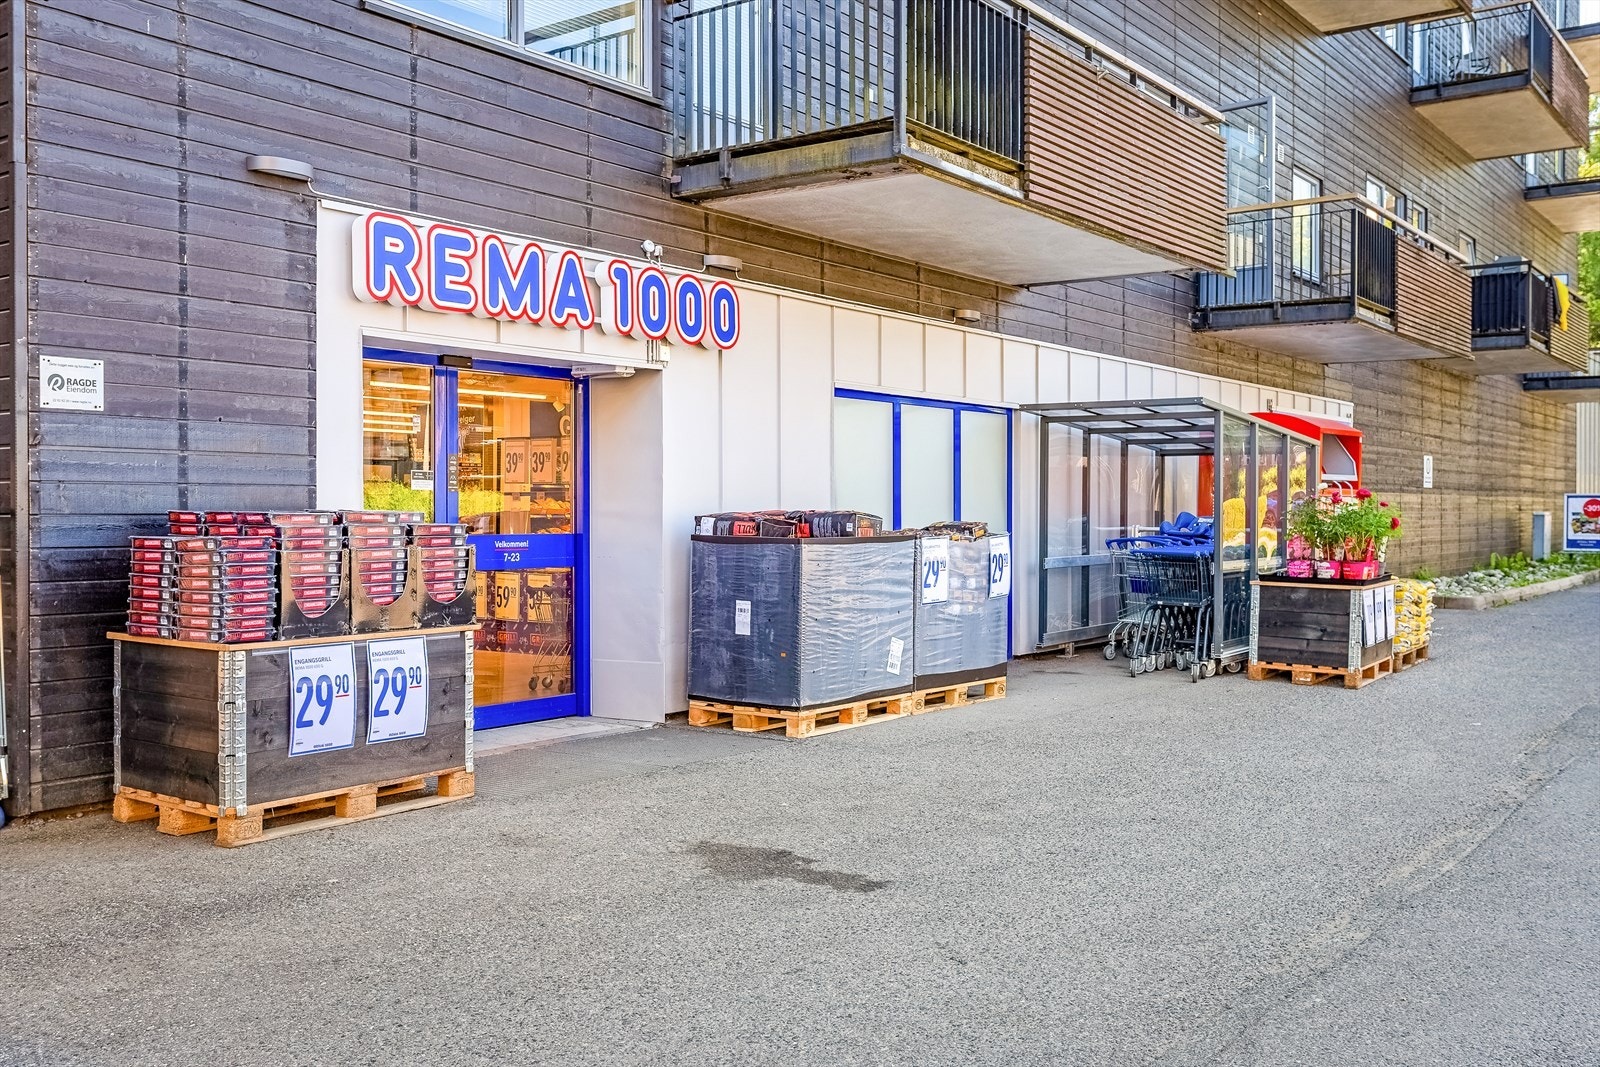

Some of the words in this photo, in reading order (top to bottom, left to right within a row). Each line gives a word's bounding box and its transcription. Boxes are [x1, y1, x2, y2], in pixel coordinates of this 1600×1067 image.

[366, 211, 595, 330] REMA
[608, 259, 740, 350] 1000
[66, 377, 97, 387] RAGDE
[66, 385, 98, 394] Eiendom
[494, 540, 529, 548] Velkommen!
[503, 552, 520, 562] 7-23
[923, 556, 940, 589] 29
[992, 553, 1004, 584] 29
[496, 585, 510, 609] 59
[294, 656, 332, 666] ENGANGSGRILL
[372, 649, 406, 658] ENGANGSGRILL
[374, 666, 408, 718] 29
[408, 666, 422, 686] 90
[296, 674, 334, 729] 29
[335, 673, 350, 694] 90
